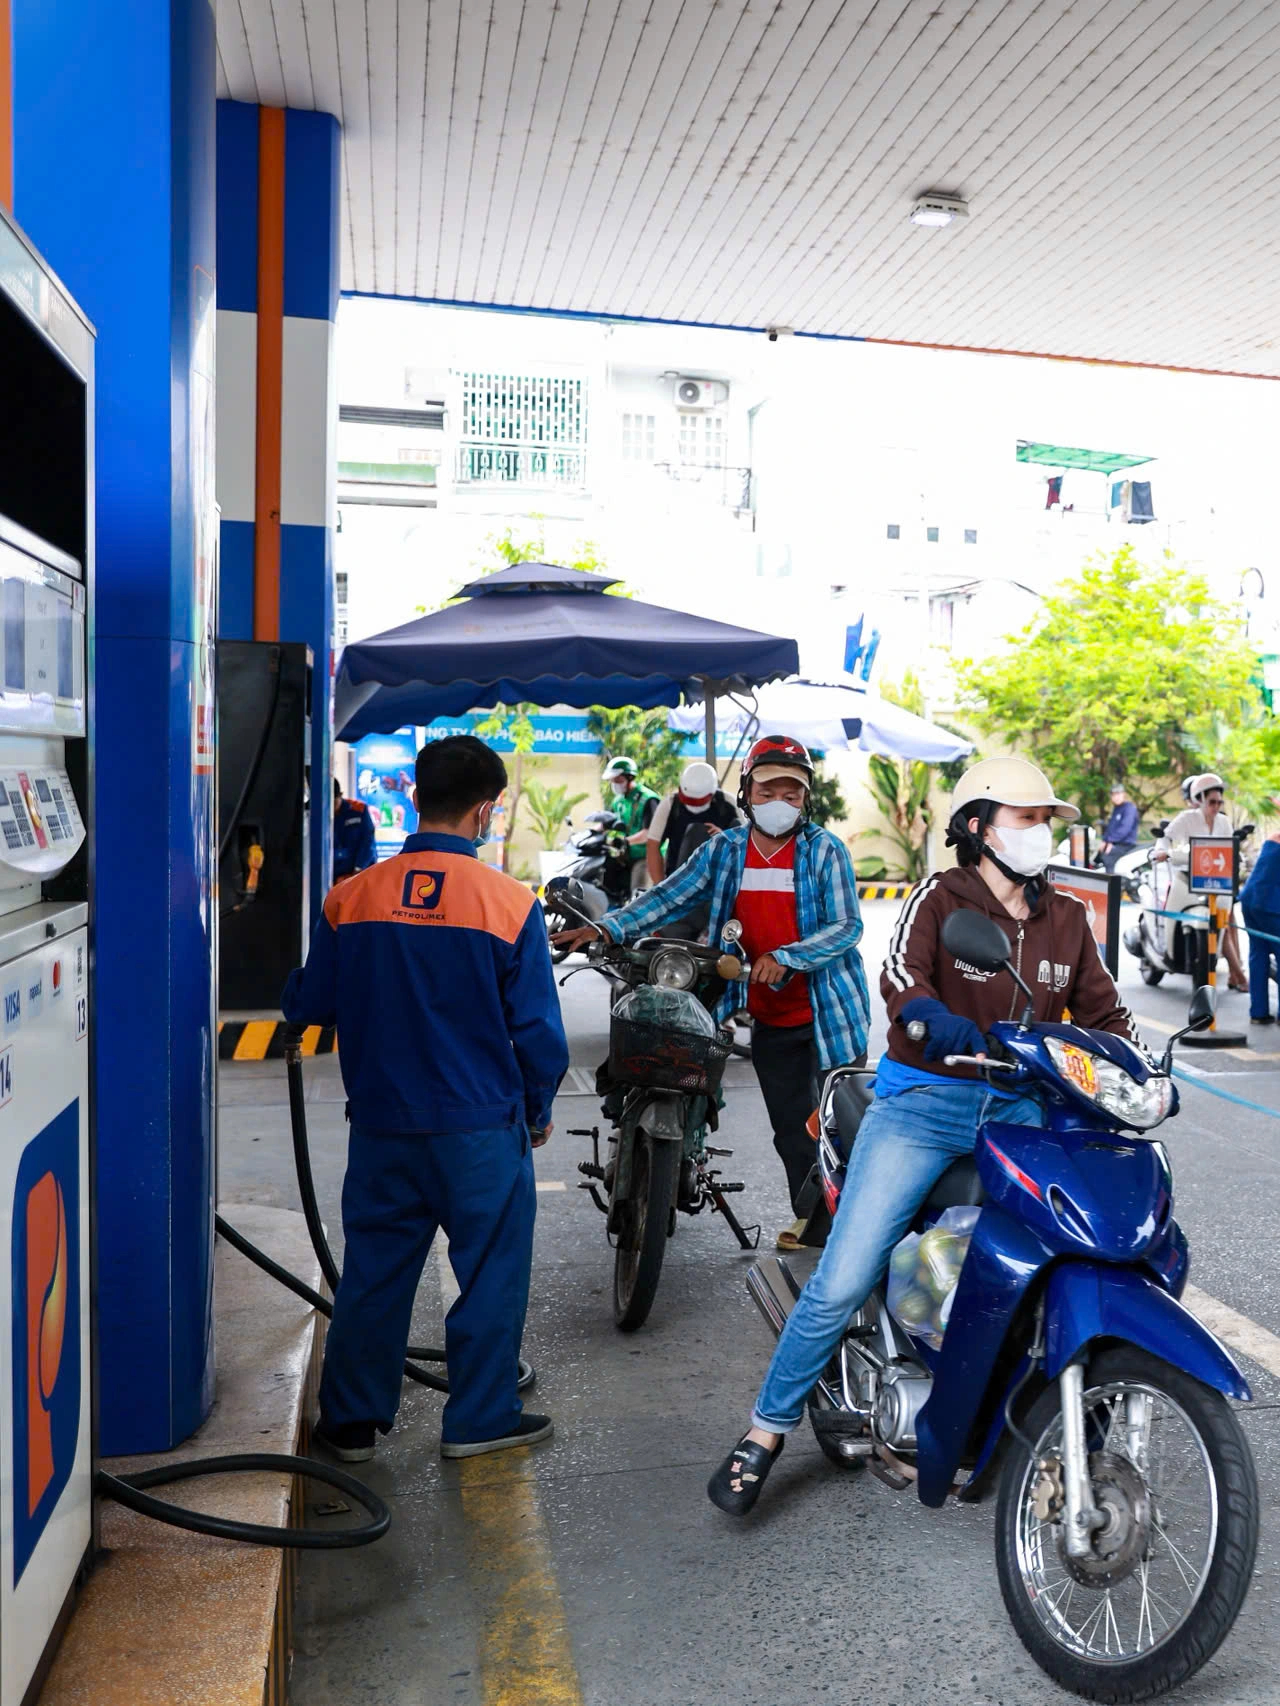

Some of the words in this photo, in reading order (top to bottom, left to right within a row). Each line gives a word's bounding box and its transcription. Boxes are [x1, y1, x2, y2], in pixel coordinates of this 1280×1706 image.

[392, 910, 446, 920] PETROLIMEX
[5, 990, 21, 1024] VISA
[77, 998, 86, 1033] 13
[0, 1054, 11, 1098] 14
